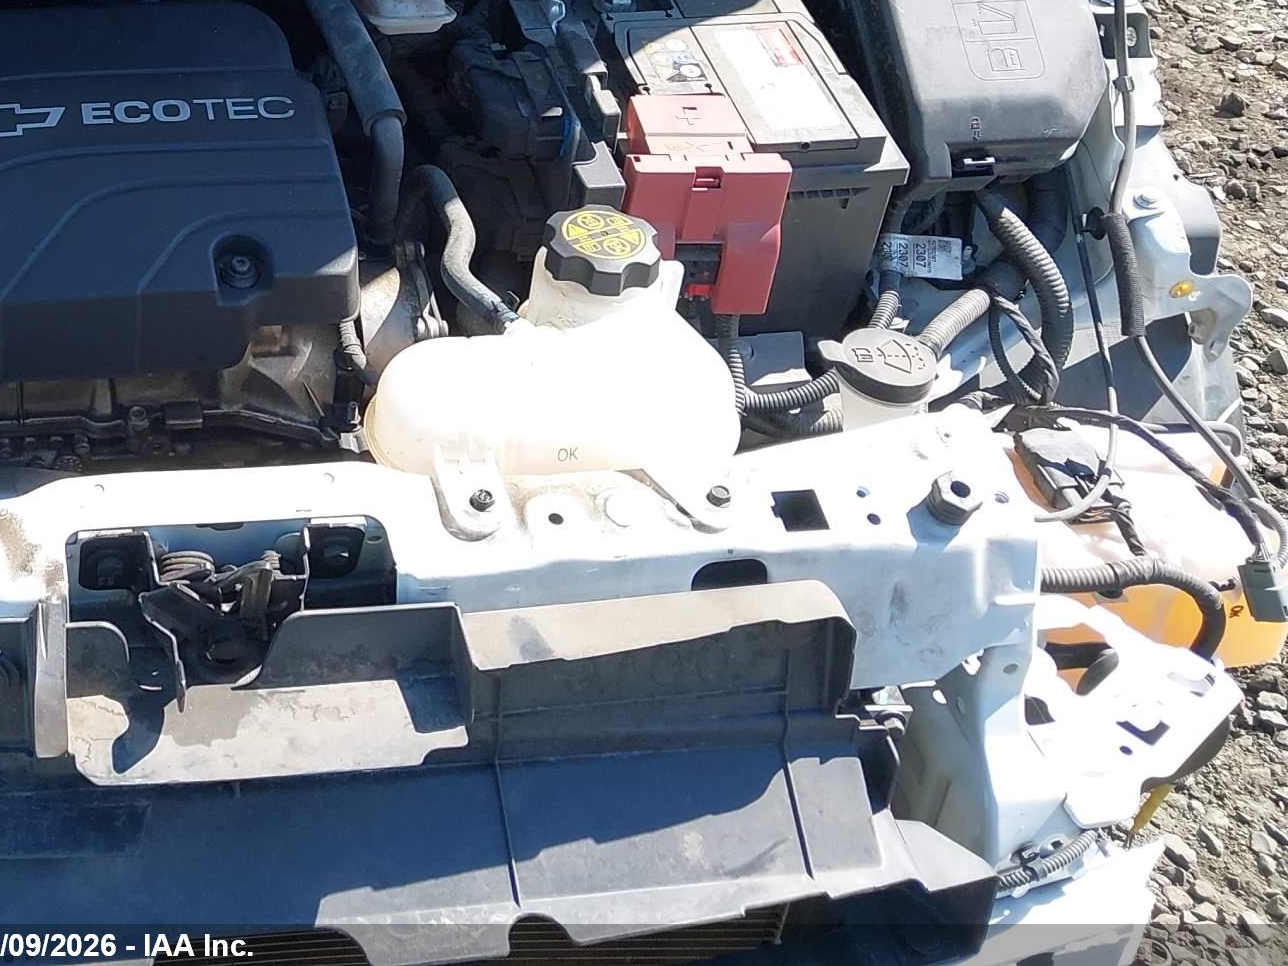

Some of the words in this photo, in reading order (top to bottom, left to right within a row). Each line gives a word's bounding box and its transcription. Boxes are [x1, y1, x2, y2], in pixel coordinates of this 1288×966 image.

[81, 96, 295, 125] ECOTEC
[898, 242, 909, 268] 2307
[915, 243, 927, 269] 2307
[557, 447, 578, 462] OK
[1228, 605, 1244, 618] OK
